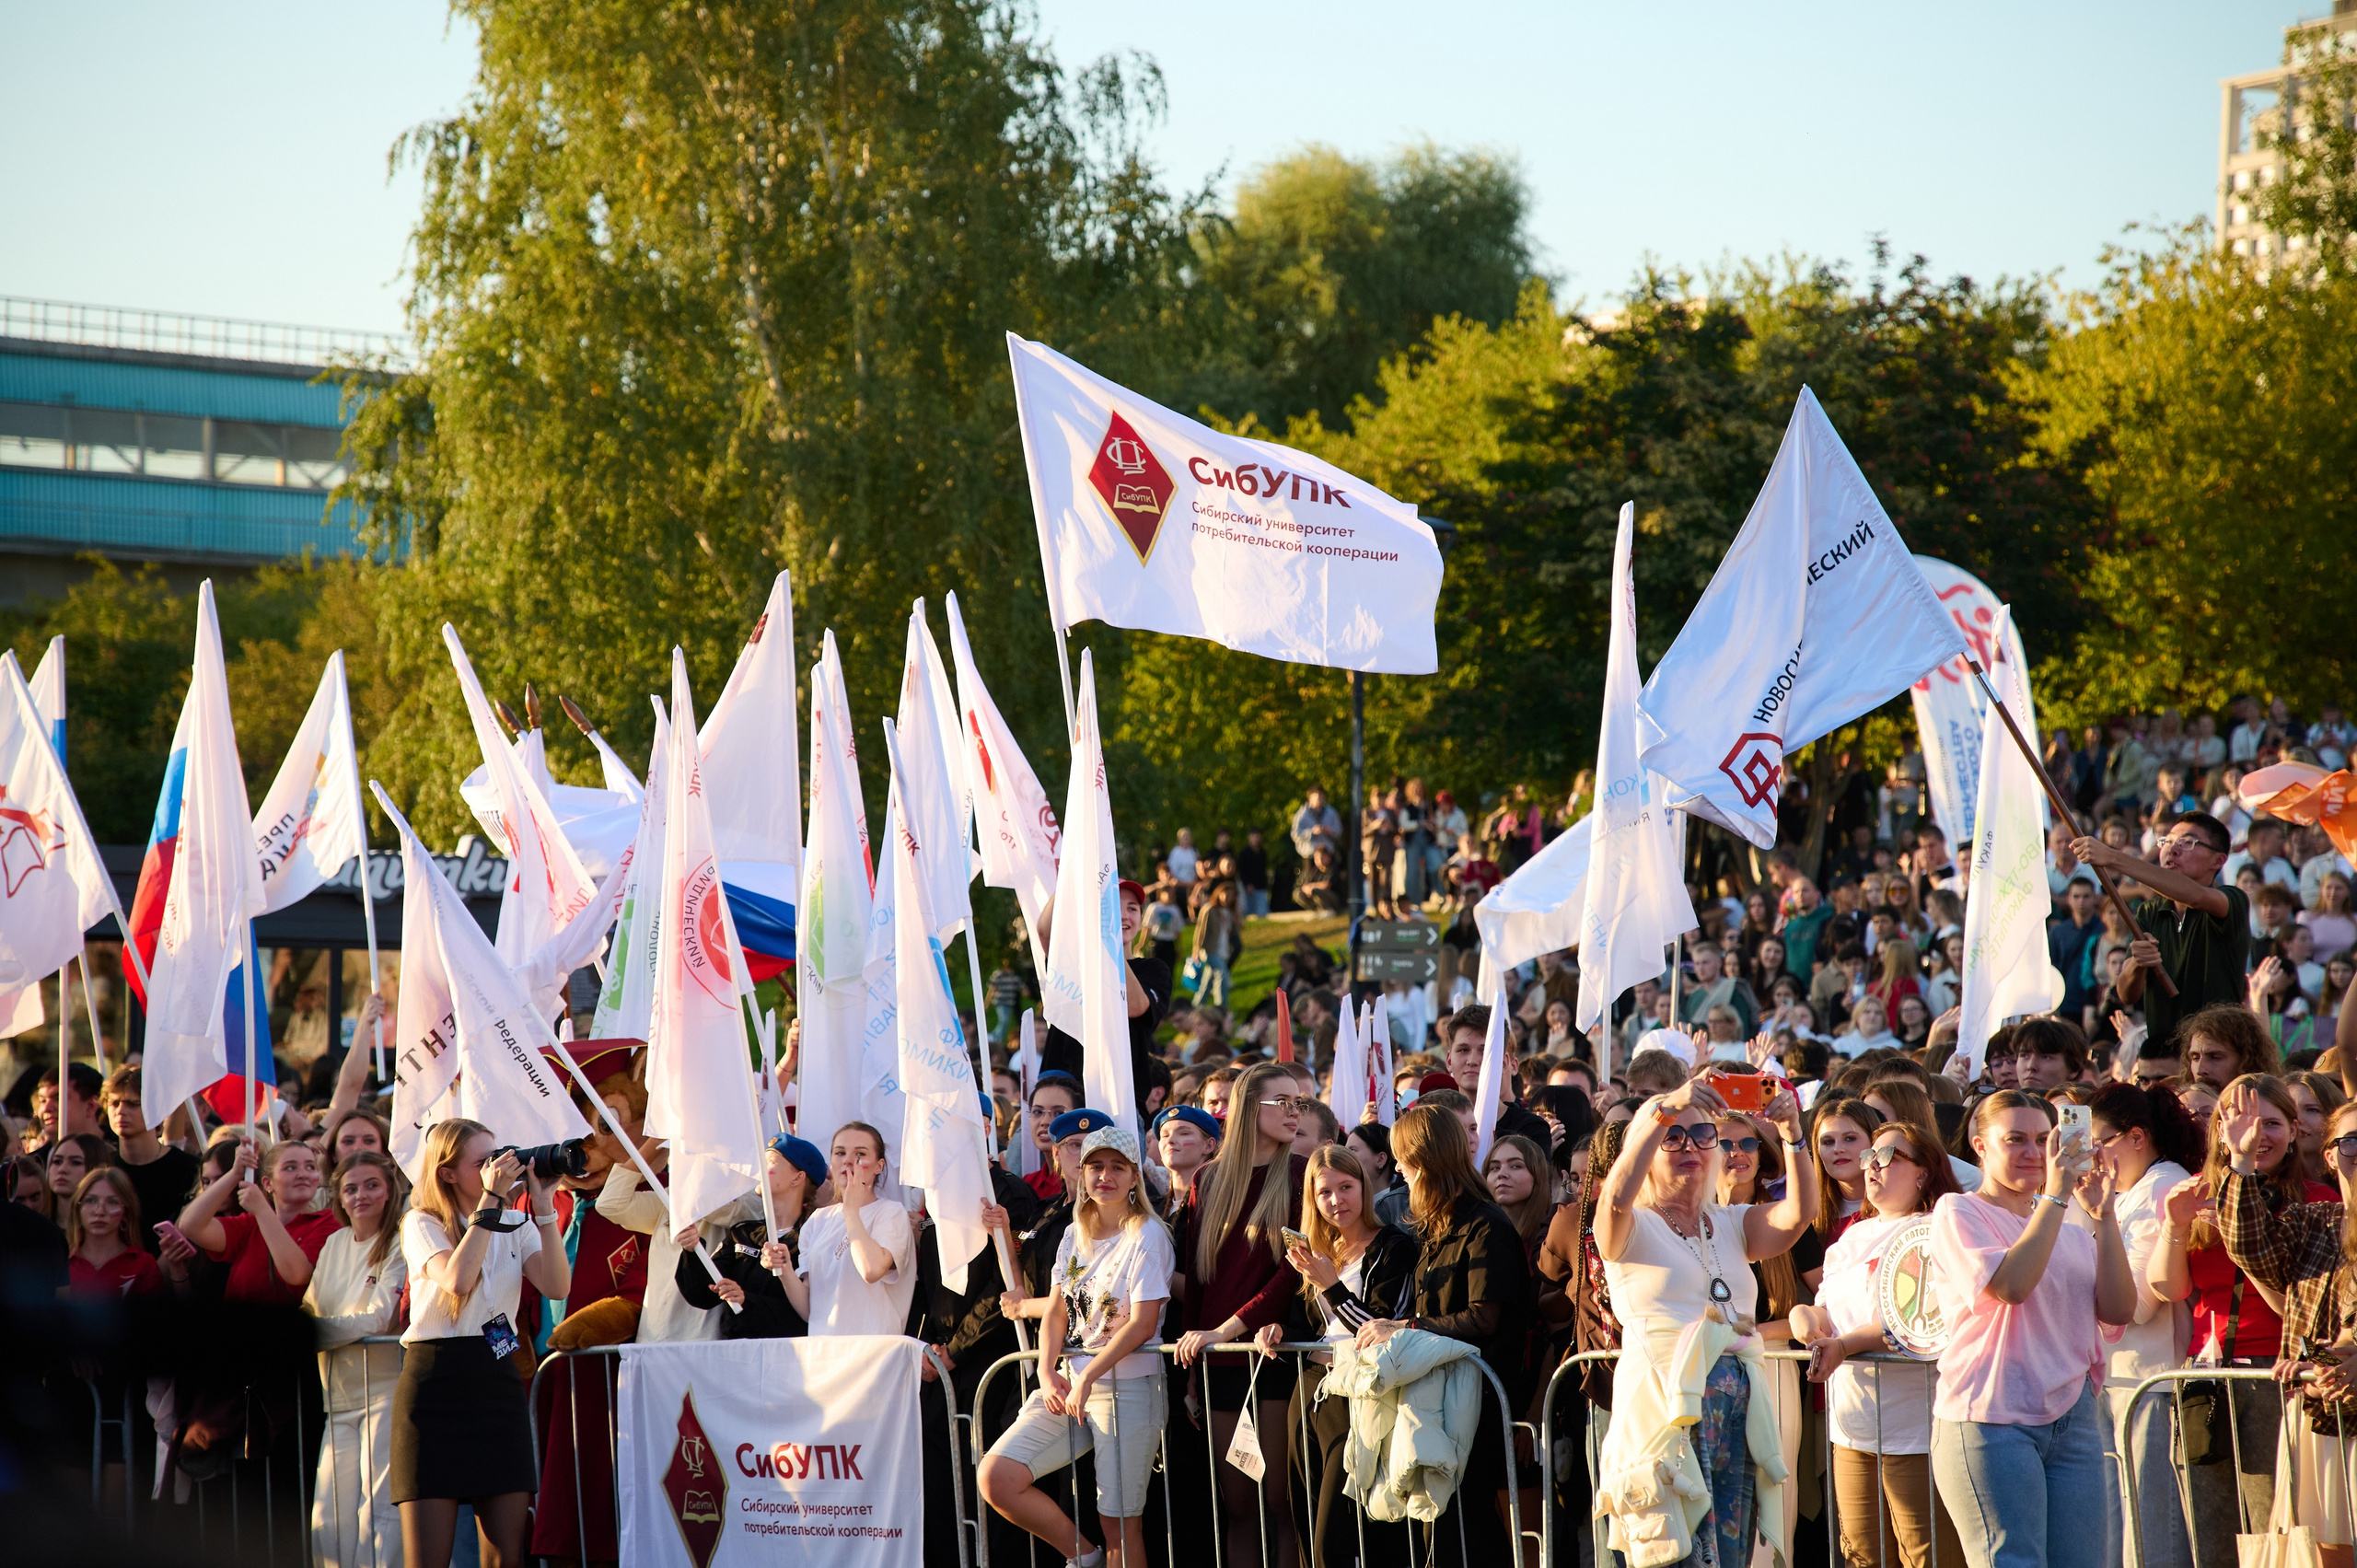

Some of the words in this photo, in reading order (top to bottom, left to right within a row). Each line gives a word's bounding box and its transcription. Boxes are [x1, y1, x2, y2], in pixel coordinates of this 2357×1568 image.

[1121, 492, 1152, 504] СибУПК
[1188, 457, 1352, 508] СибУПК
[1192, 501, 1261, 527] Сибирский
[1266, 518, 1355, 538] университет
[1191, 522, 1302, 552] потребительской
[1306, 544, 1399, 562] кооперации
[1806, 520, 1875, 586] ЕСКИЙ
[1879, 1239, 1905, 1331] НОВОСИБИРСКИЙ
[1905, 1225, 1930, 1244] АВТОТ
[496, 1342, 519, 1360] ДИА
[736, 1443, 864, 1481] СибУПК
[688, 1500, 714, 1511] СибУПК
[741, 1498, 800, 1517] Сибирский
[802, 1504, 873, 1519] университет
[744, 1521, 835, 1538] потребительской
[838, 1526, 902, 1540] кооперации
